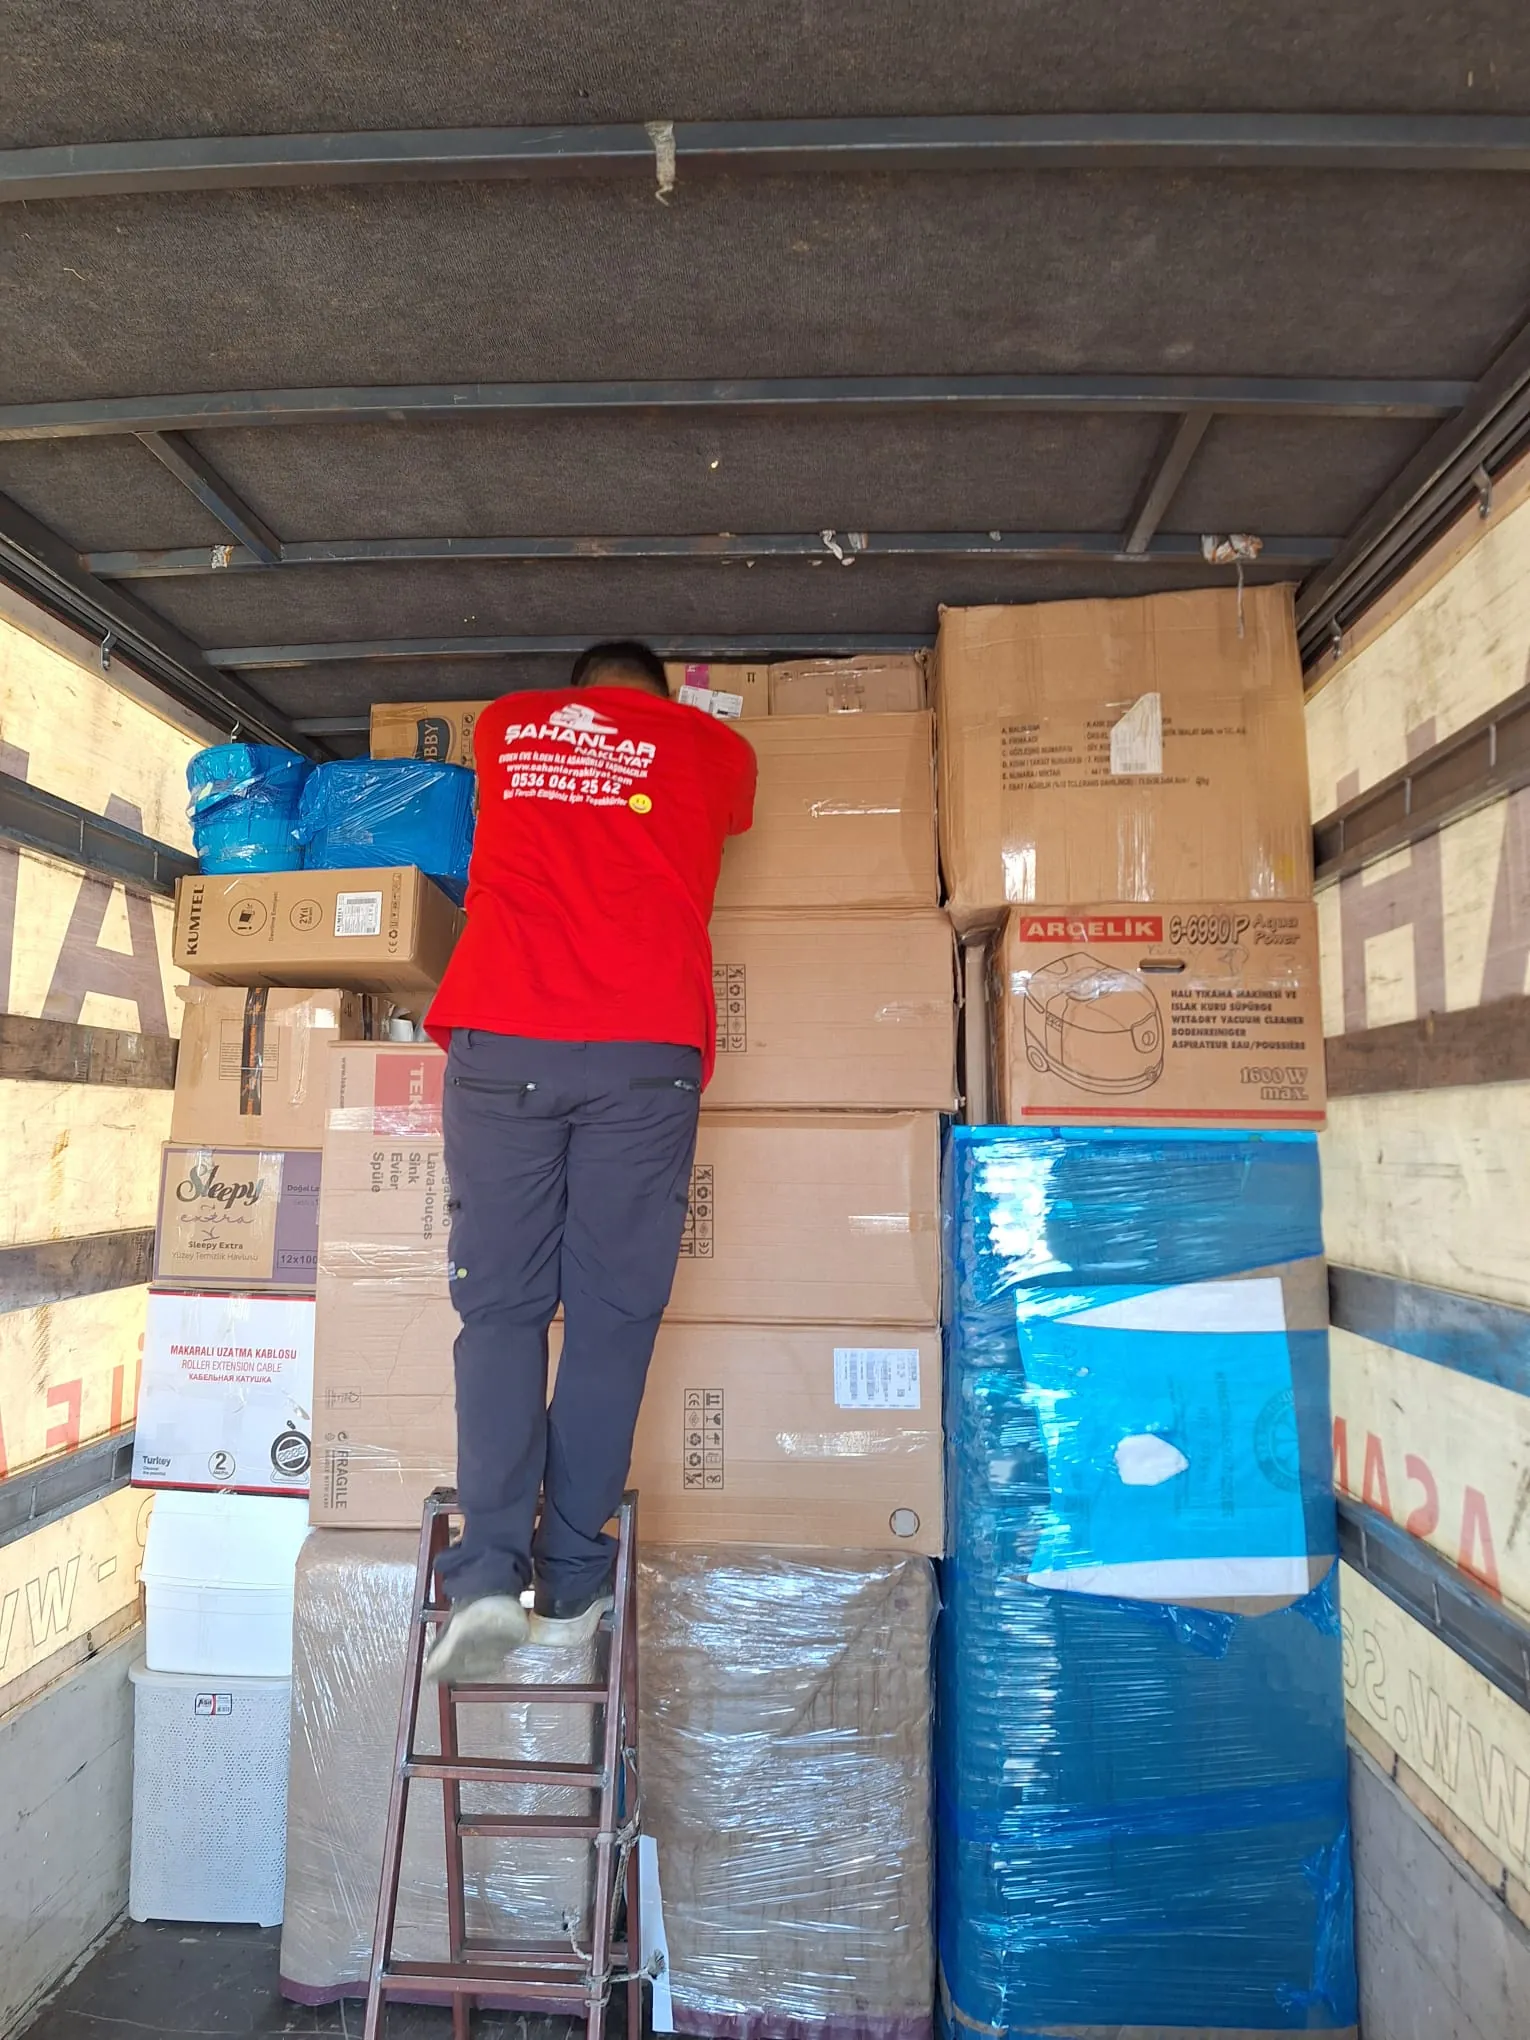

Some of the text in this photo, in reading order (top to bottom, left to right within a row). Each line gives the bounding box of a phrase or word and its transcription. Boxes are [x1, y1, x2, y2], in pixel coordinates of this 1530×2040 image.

[424, 723, 439, 763] BBY
[504, 723, 656, 759] ŞAHANLAR
[574, 746, 653, 769] NAKLİYAT
[511, 773, 622, 795] 0536 064 25 42
[185, 884, 205, 955] KUMTEL
[1252, 913, 1300, 932] Aqua
[1026, 919, 1156, 941] ARÇELİK
[1255, 930, 1301, 946] Power
[1171, 989, 1192, 999] HALI
[1195, 989, 1233, 999] YIKAMA
[1285, 990, 1297, 1000] VE
[1171, 1001, 1272, 1012] ISLAK KURU SÜPÜRGE
[1171, 1015, 1305, 1025] WET&DRY VACUUM CLEANER
[1171, 1027, 1247, 1037] BODENREINIGER
[1171, 1040, 1229, 1050] ASPIRATEUR
[1240, 1066, 1309, 1085] 1600 W
[1260, 1086, 1310, 1101] max.
[371, 1151, 384, 1193] Spüle
[390, 1152, 402, 1190] Evier
[408, 1151, 420, 1184] Sink
[176, 1164, 265, 1210] Sleepy
[423, 1151, 439, 1240] Lava-louças
[187, 1241, 243, 1250] Sleepy Extra
[170, 1345, 297, 1360] MAKARALI UZATMA KABLOSU
[182, 1359, 282, 1373] ROLLER EXTENSION CABLE
[189, 1373, 272, 1384] КАБЕЛЬНАЯ КАТУШКА
[142, 1455, 171, 1467] Turkey
[215, 1452, 227, 1470] 2
[335, 1450, 348, 1509] FRAGILE
